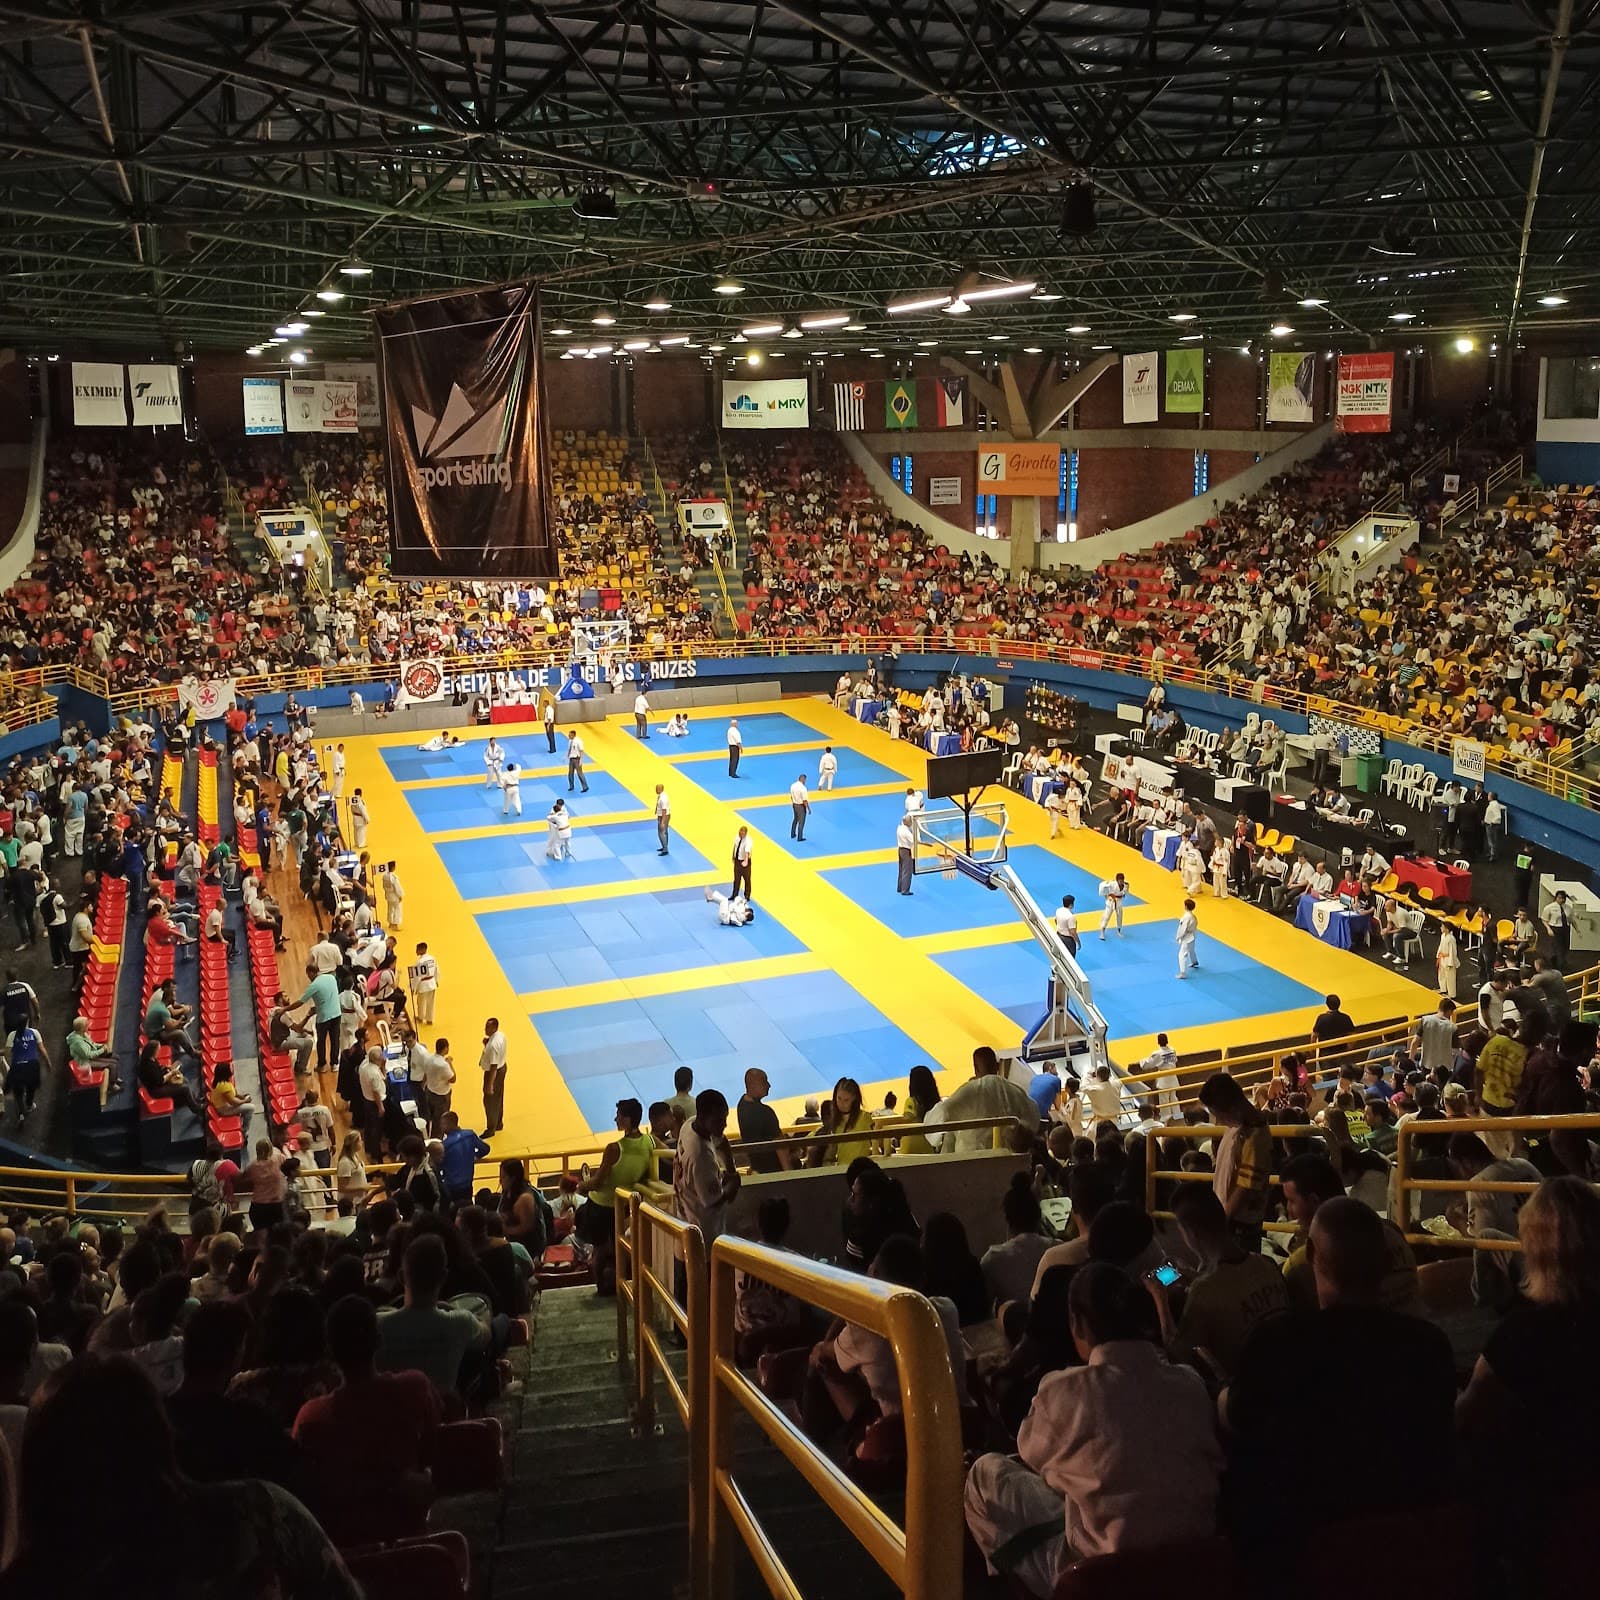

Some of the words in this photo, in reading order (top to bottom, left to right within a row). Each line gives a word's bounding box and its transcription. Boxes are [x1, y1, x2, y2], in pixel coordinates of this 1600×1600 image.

[1173, 381, 1195, 393] DEMAX
[1341, 384, 1361, 394] NGK
[1365, 382, 1387, 393] NTK
[779, 398, 806, 409] MRV
[984, 454, 1000, 480] G
[416, 460, 513, 493] sportsking
[529, 668, 549, 688] DE
[643, 660, 697, 680] RUZES
[351, 796, 358, 804] 6
[1344, 856, 1350, 865] 9
[378, 864, 386, 873] 8
[1318, 912, 1324, 923] 9
[414, 965, 427, 976] 10
